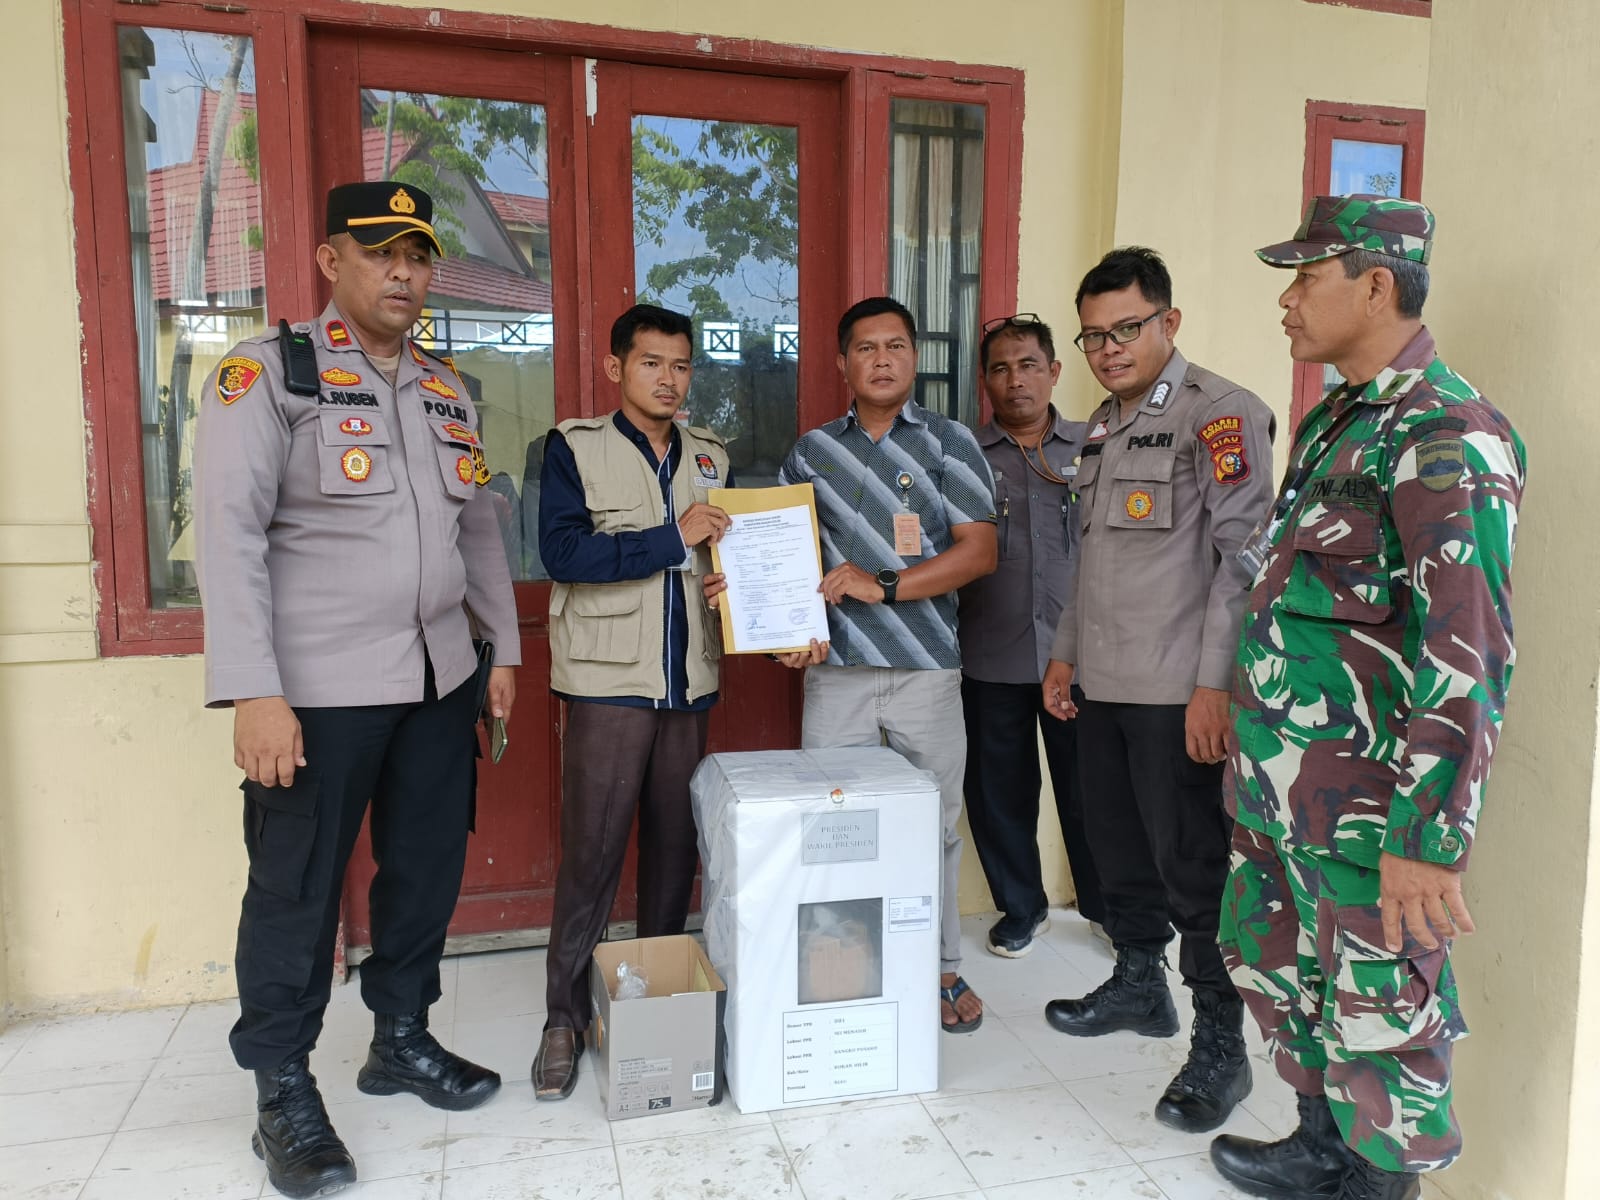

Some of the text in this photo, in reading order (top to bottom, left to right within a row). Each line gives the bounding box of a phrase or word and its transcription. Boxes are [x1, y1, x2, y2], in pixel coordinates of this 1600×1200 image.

[318, 391, 379, 407] A.RUBEN
[424, 401, 467, 423] POLRI
[1202, 418, 1238, 437] POLRES
[1128, 433, 1174, 450] POLRI
[1212, 436, 1239, 449] RIAU
[821, 824, 861, 833] PRESIDEN
[807, 839, 874, 850] WAKIL PRESIDEN
[651, 1098, 664, 1108] 75
